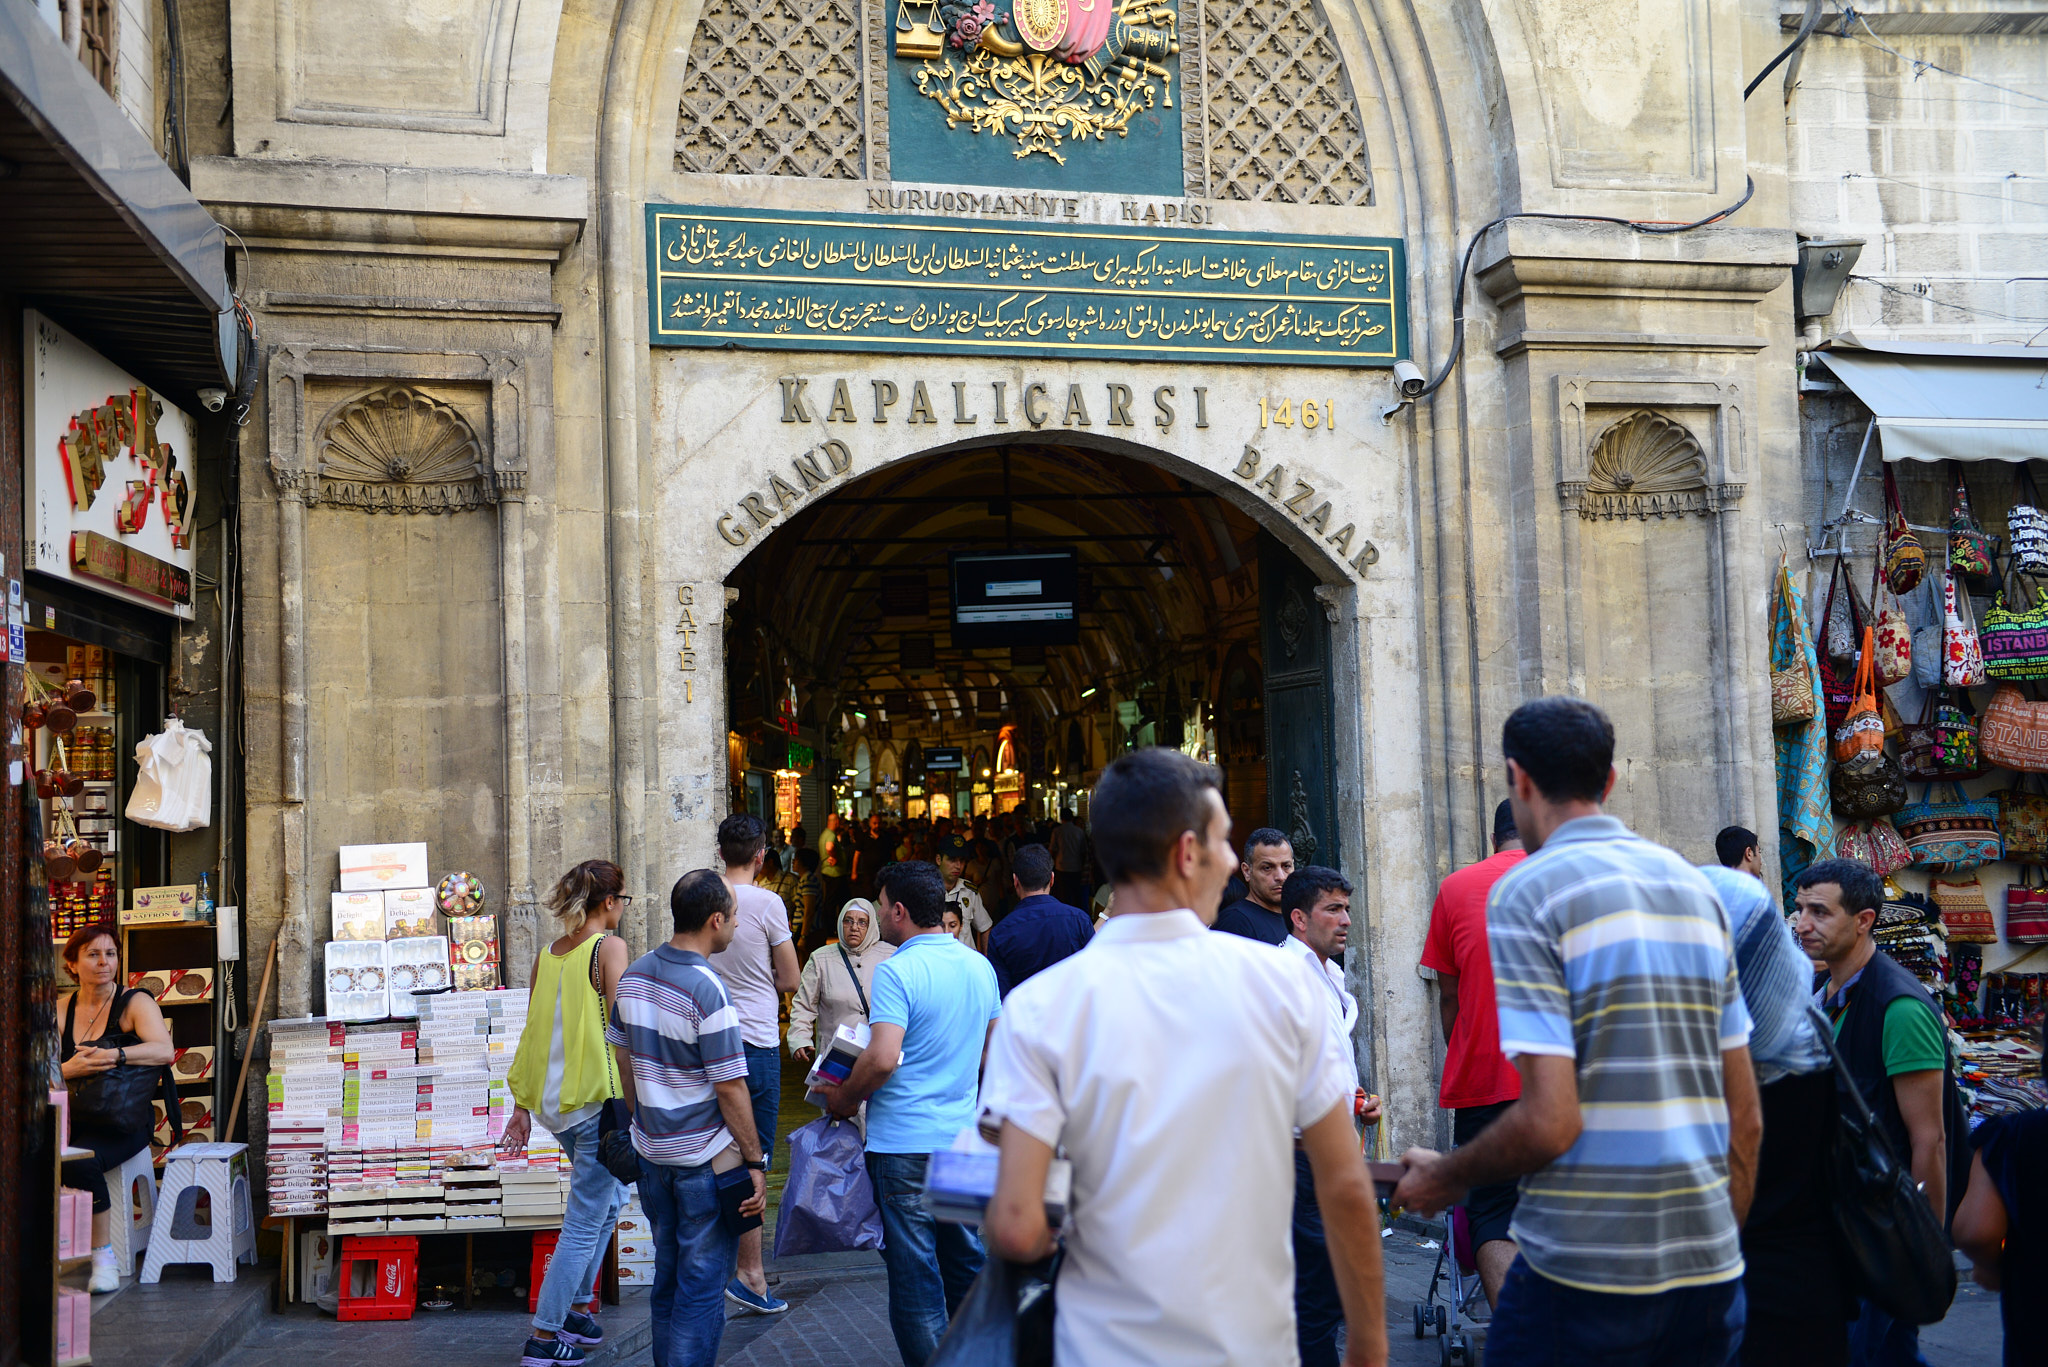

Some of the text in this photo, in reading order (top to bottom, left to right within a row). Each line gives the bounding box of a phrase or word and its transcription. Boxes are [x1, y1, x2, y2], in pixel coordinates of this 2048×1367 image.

[866, 187, 1214, 225] NURUOSMANİYE KAPISI
[1259, 397, 1336, 431] 1461
[716, 438, 1380, 578] GRAND BAZAAR
[90, 539, 189, 598] Turkish Delight & Spice
[676, 585, 698, 672] GATE
